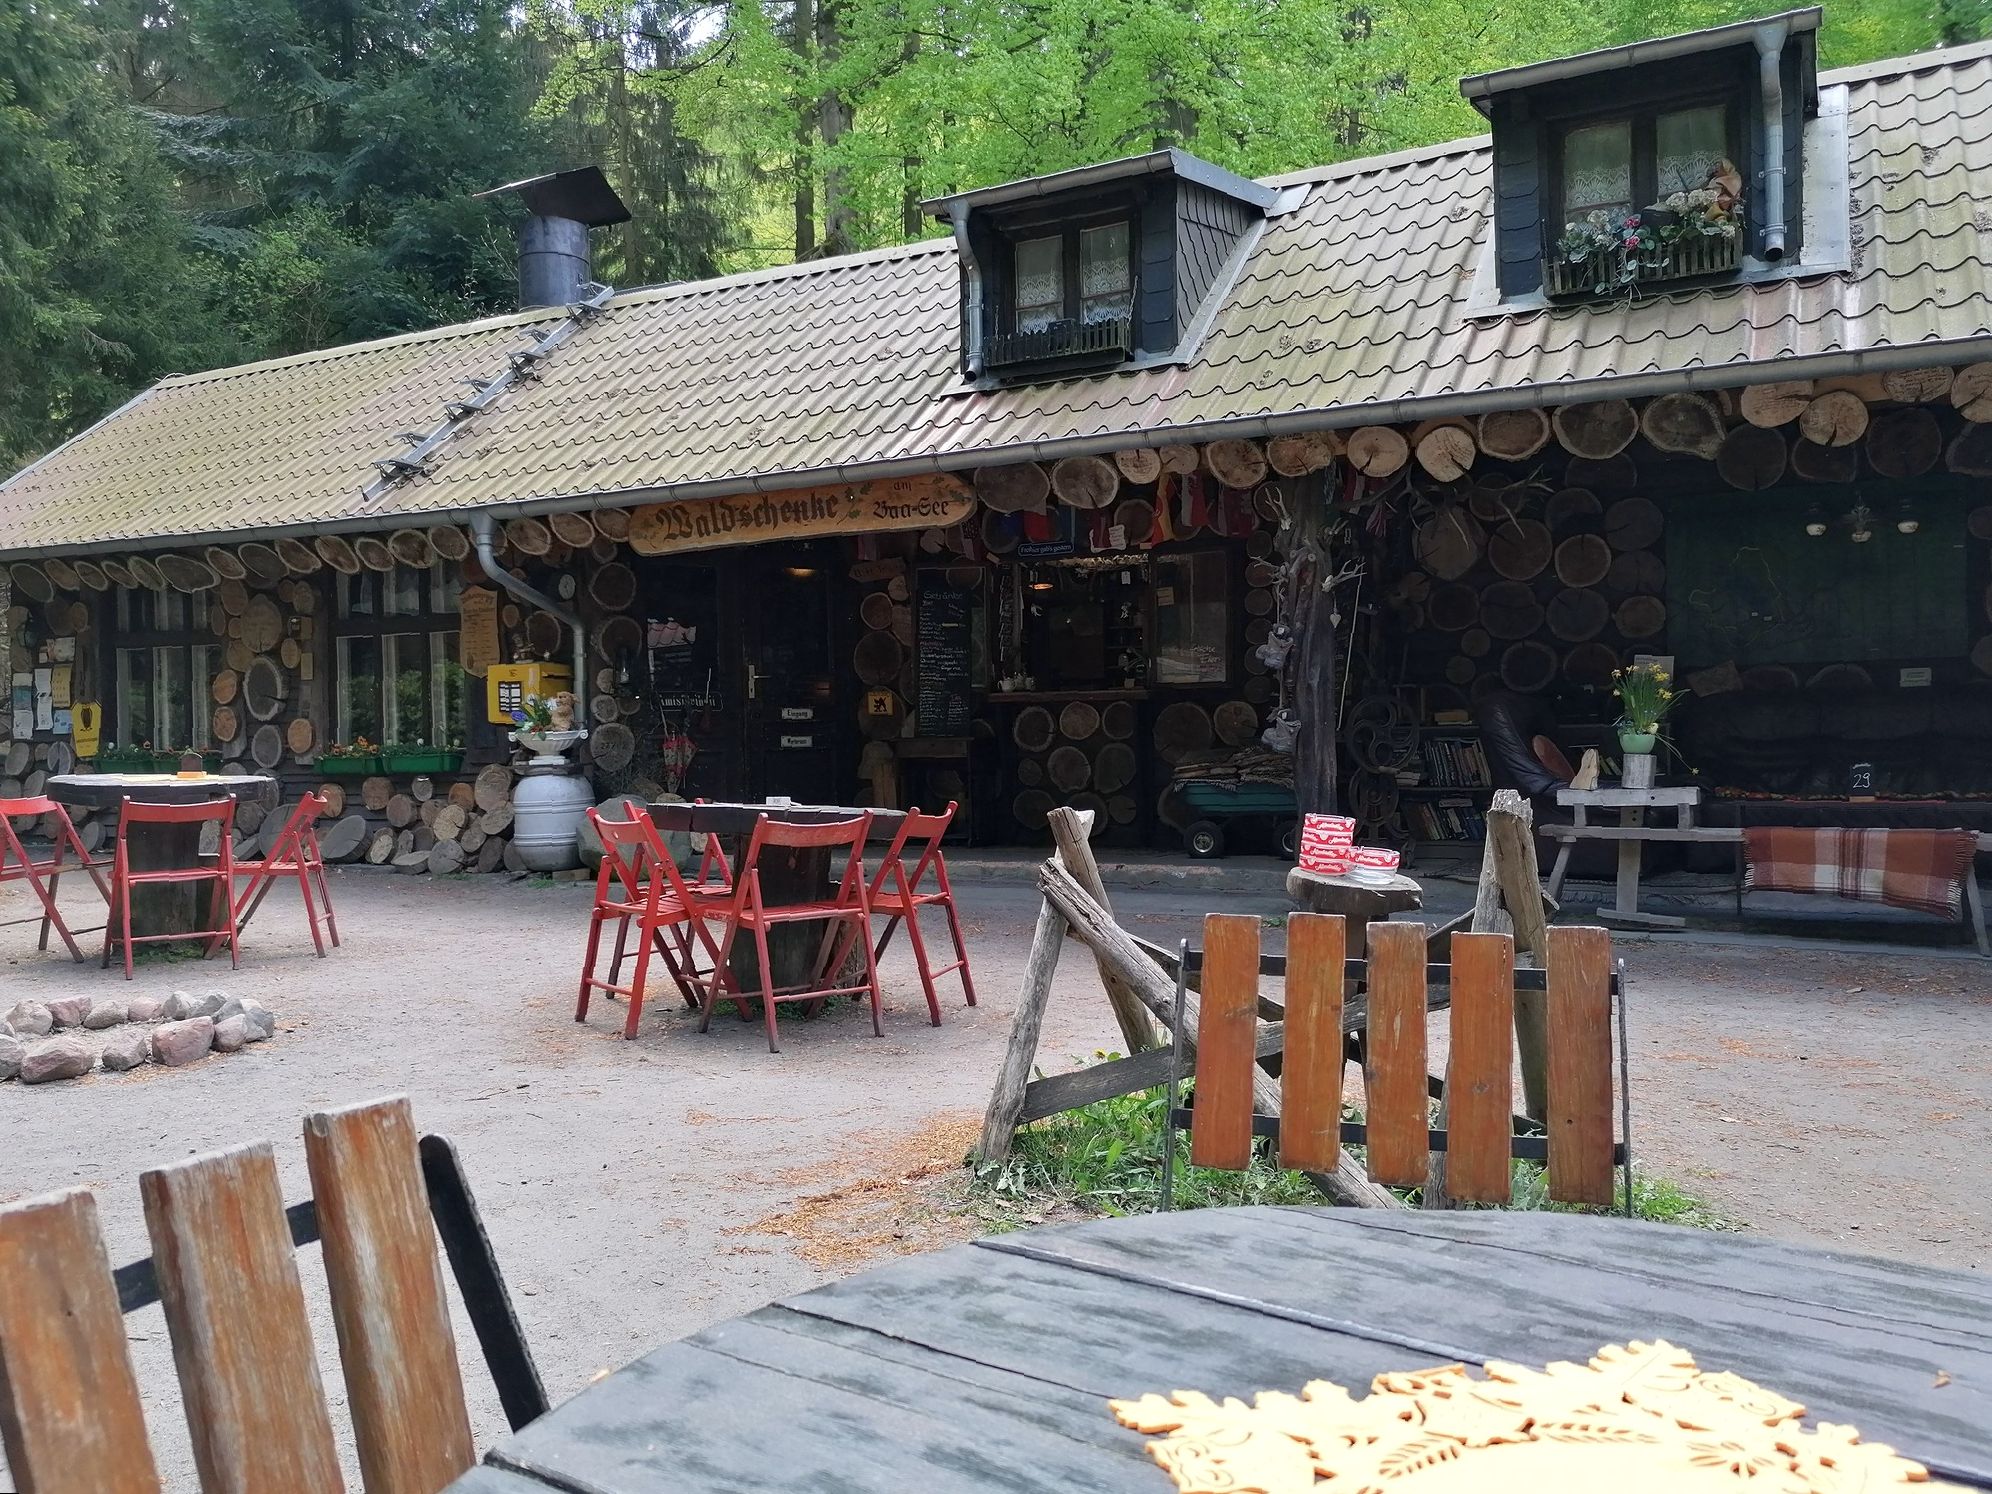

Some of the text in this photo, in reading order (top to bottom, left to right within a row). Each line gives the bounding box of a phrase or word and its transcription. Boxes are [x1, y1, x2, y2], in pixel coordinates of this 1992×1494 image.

[893, 481, 912, 491] am
[872, 496, 949, 519] Baa-See
[655, 491, 840, 541] Waldschenke
[787, 709, 808, 718] Eingang
[1852, 772, 1871, 788] 29
